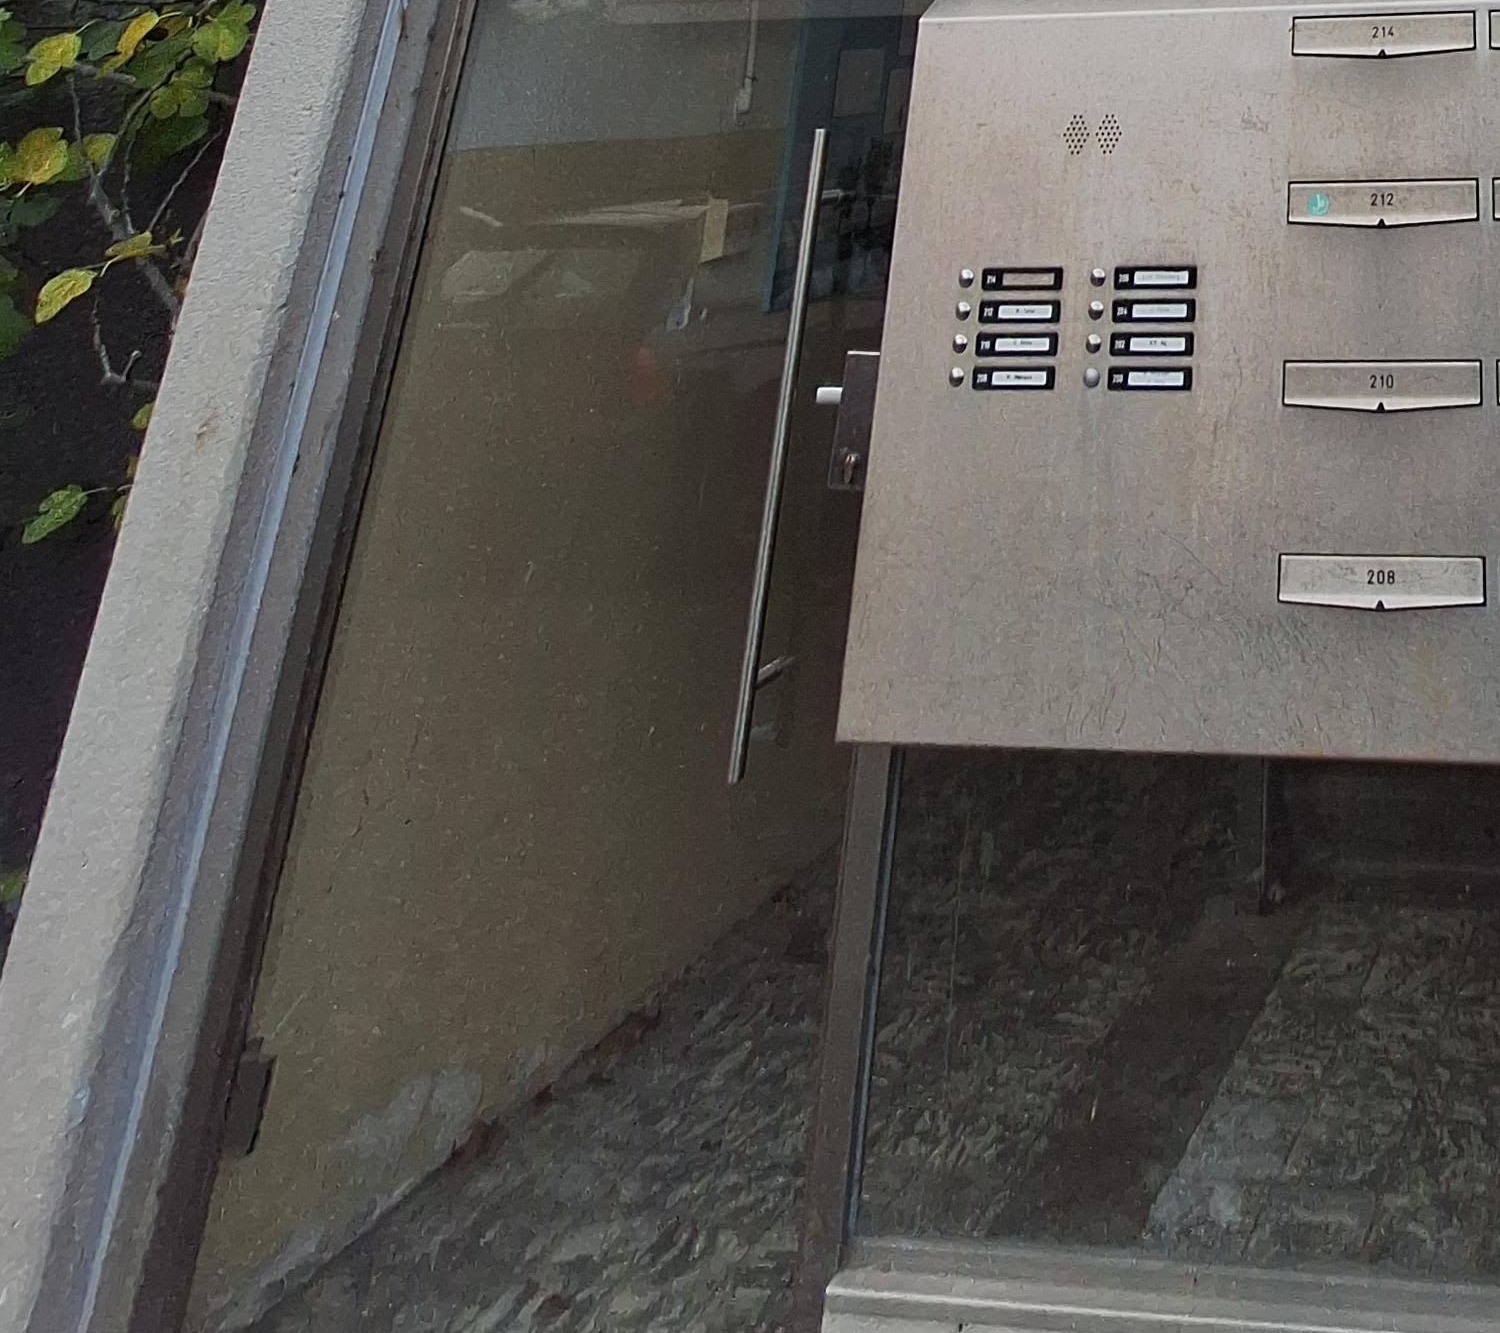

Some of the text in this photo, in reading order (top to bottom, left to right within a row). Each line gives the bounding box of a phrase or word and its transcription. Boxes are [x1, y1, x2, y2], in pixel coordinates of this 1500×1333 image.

[1371, 25, 1395, 39] 214
[1370, 192, 1394, 207] 212
[1369, 373, 1394, 389] 210
[1366, 569, 1396, 586] 208
